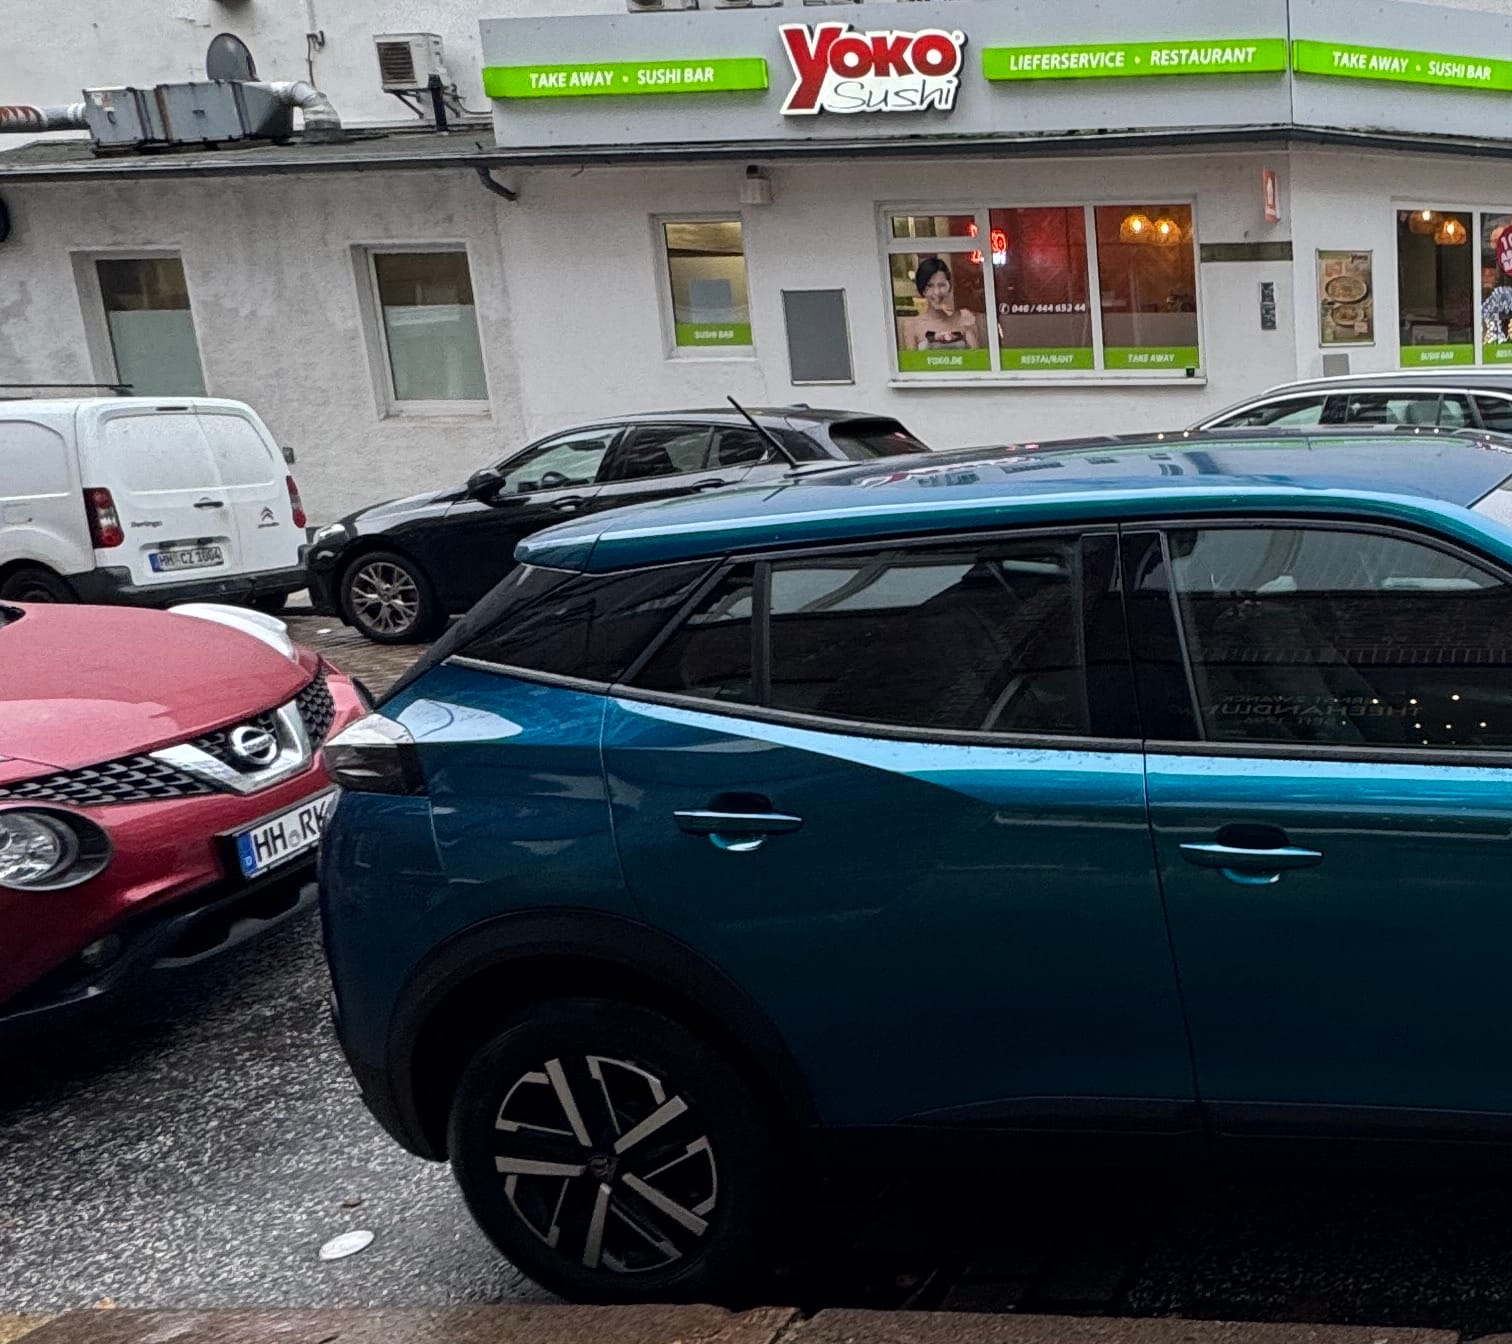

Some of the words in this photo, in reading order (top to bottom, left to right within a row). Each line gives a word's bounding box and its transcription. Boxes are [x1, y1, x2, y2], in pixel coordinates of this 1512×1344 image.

[783, 27, 957, 110] YOKO
[1010, 51, 1125, 71] LIEFERSERVICE
[1150, 47, 1256, 66] RESTAURANT
[1333, 51, 1366, 68] TAKE
[1368, 56, 1409, 73] AWAY
[1428, 61, 1465, 78] SUSHI
[1467, 65, 1492, 80] BAR
[530, 72, 566, 88] TAKE
[569, 71, 613, 87] AWAY
[637, 69, 681, 85] SUSHI
[684, 67, 714, 83] BAR
[827, 79, 954, 109] Sushi
[1021, 354, 1074, 364] RESTAURANT
[1128, 354, 1149, 363] TAKE
[1150, 354, 1175, 363] AWAY
[253, 822, 288, 863] HH
